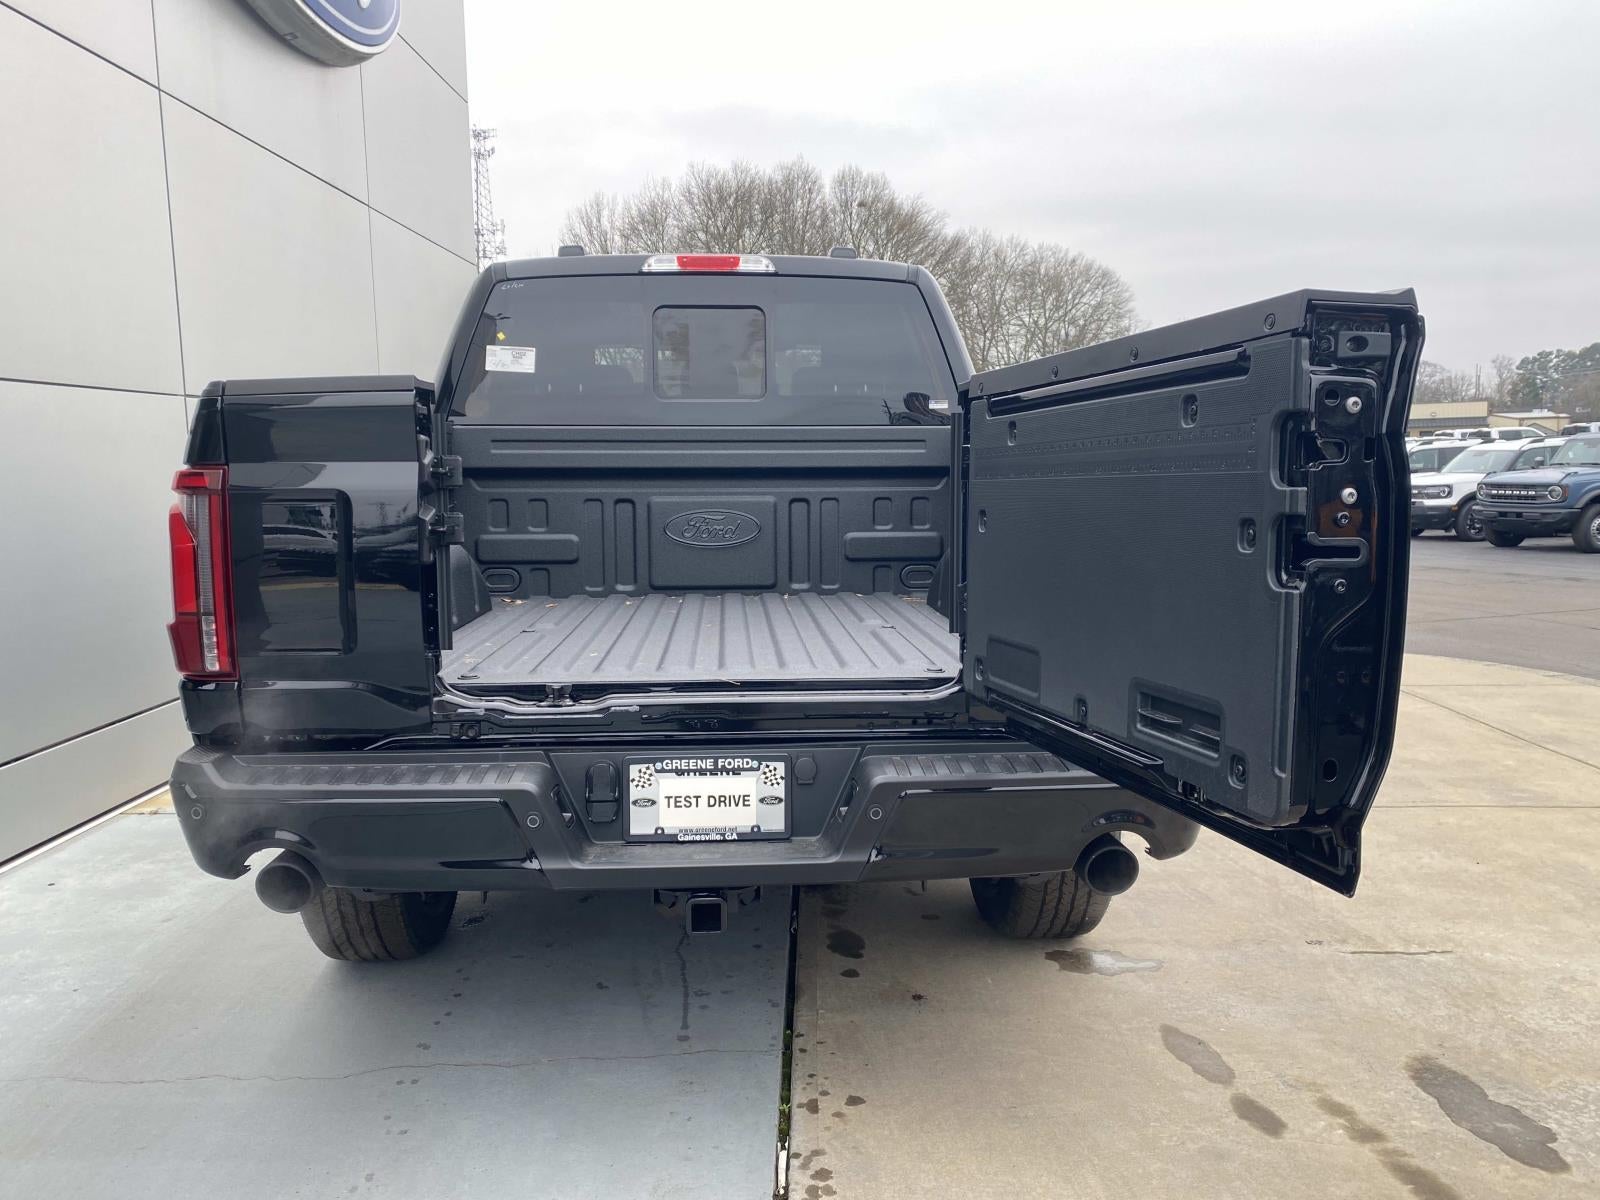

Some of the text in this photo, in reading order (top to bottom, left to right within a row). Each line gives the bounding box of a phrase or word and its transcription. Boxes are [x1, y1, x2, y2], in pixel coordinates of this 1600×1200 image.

[682, 514, 741, 539] Ford
[662, 758, 752, 770] GREENE FORD
[664, 794, 751, 809] TEST DRIVE
[725, 832, 738, 840] GA
